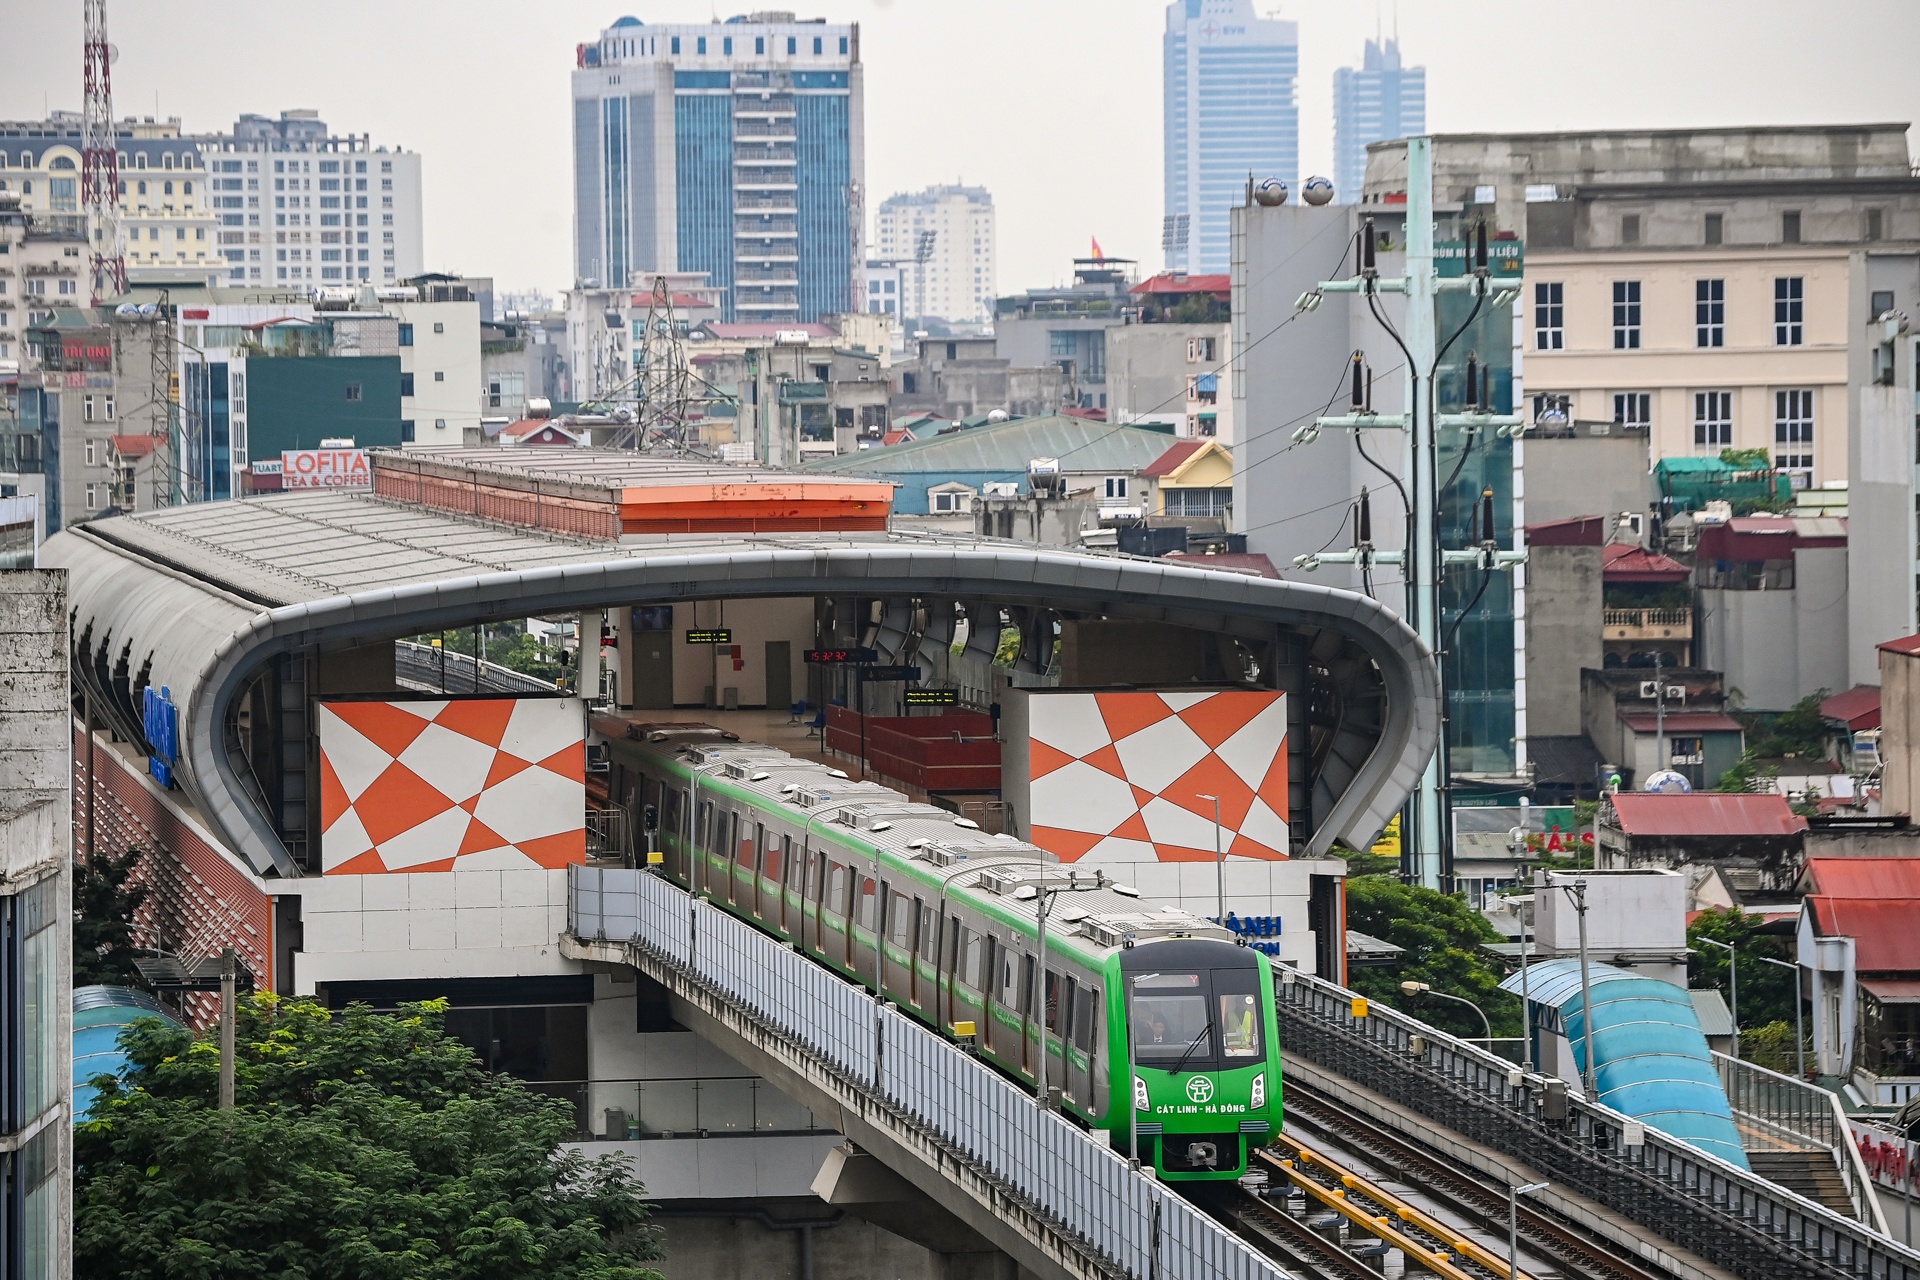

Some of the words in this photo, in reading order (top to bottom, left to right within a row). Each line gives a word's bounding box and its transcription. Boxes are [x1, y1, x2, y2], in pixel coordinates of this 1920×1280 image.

[283, 452, 367, 473] LOFITA
[284, 475, 307, 487] TEA
[311, 475, 320, 486] &
[324, 474, 369, 486] COFFEE
[1283, 973, 1294, 982] 010
[1156, 1104, 1174, 1114] CÁT
[1177, 1105, 1197, 1113] LINH
[1205, 1104, 1217, 1113] HÀ
[1220, 1103, 1245, 1113] ĐÔNG
